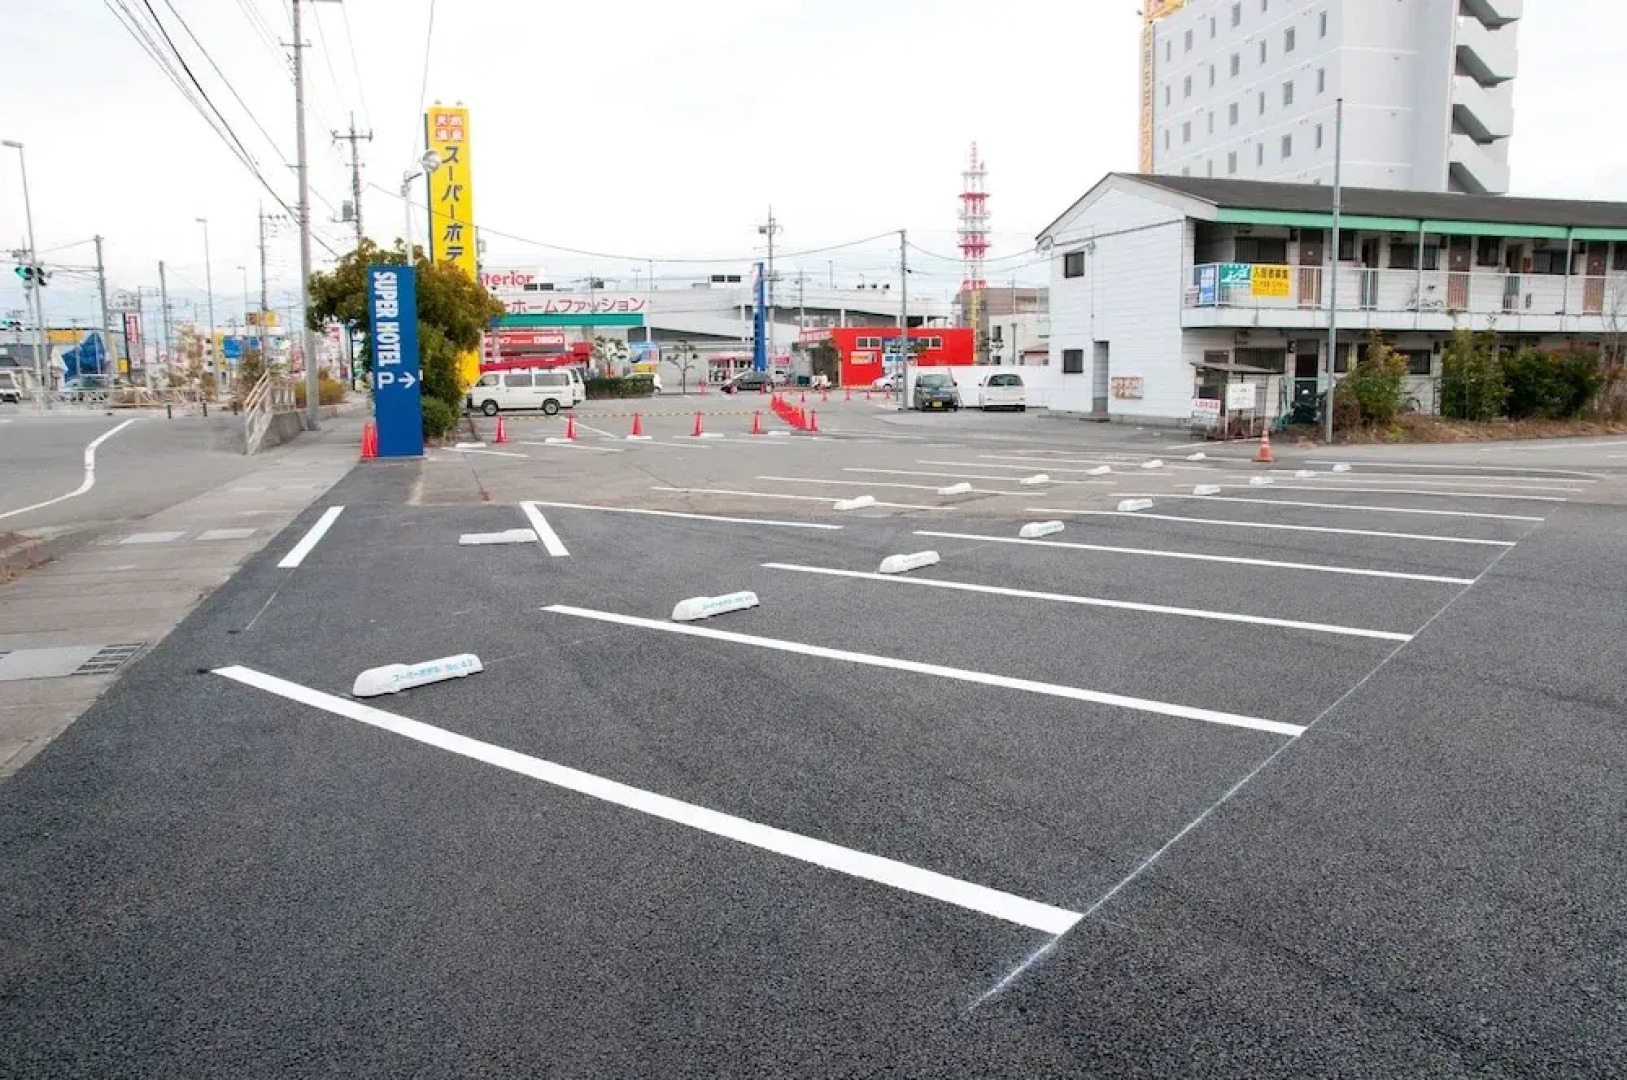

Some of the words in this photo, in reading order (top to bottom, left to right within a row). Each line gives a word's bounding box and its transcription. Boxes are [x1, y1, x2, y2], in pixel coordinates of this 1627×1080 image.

[373, 270, 399, 318] SUPER
[375, 322, 401, 367] HOTEL
[377, 371, 395, 389] P
